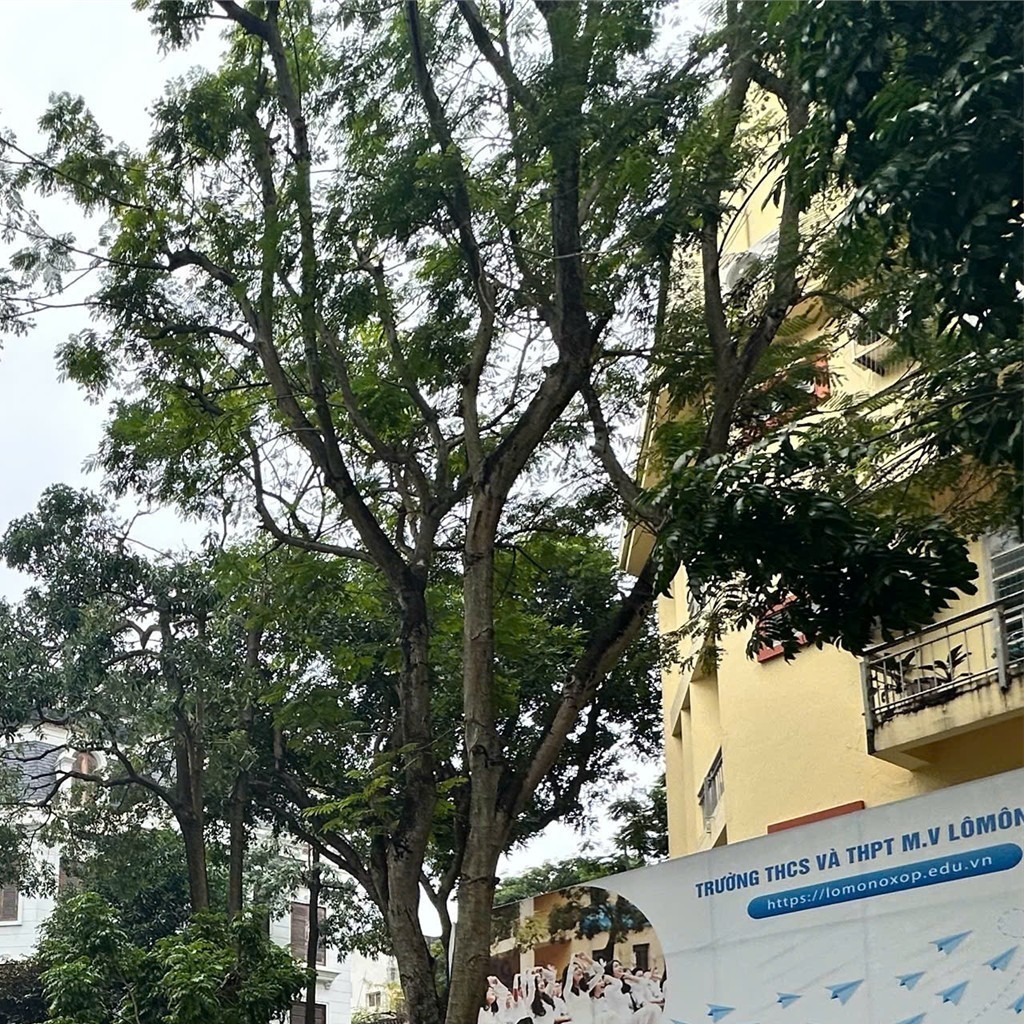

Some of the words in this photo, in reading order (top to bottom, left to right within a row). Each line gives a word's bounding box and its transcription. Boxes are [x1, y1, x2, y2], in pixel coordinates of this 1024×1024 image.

[695, 869, 760, 898] TRƯỜNG
[765, 858, 810, 883] THCS
[816, 848, 841, 872] VÀ
[846, 837, 895, 865] THPT
[902, 826, 941, 853] M.V
[767, 855, 993, 911] https://lomonoxop.edu.vn
